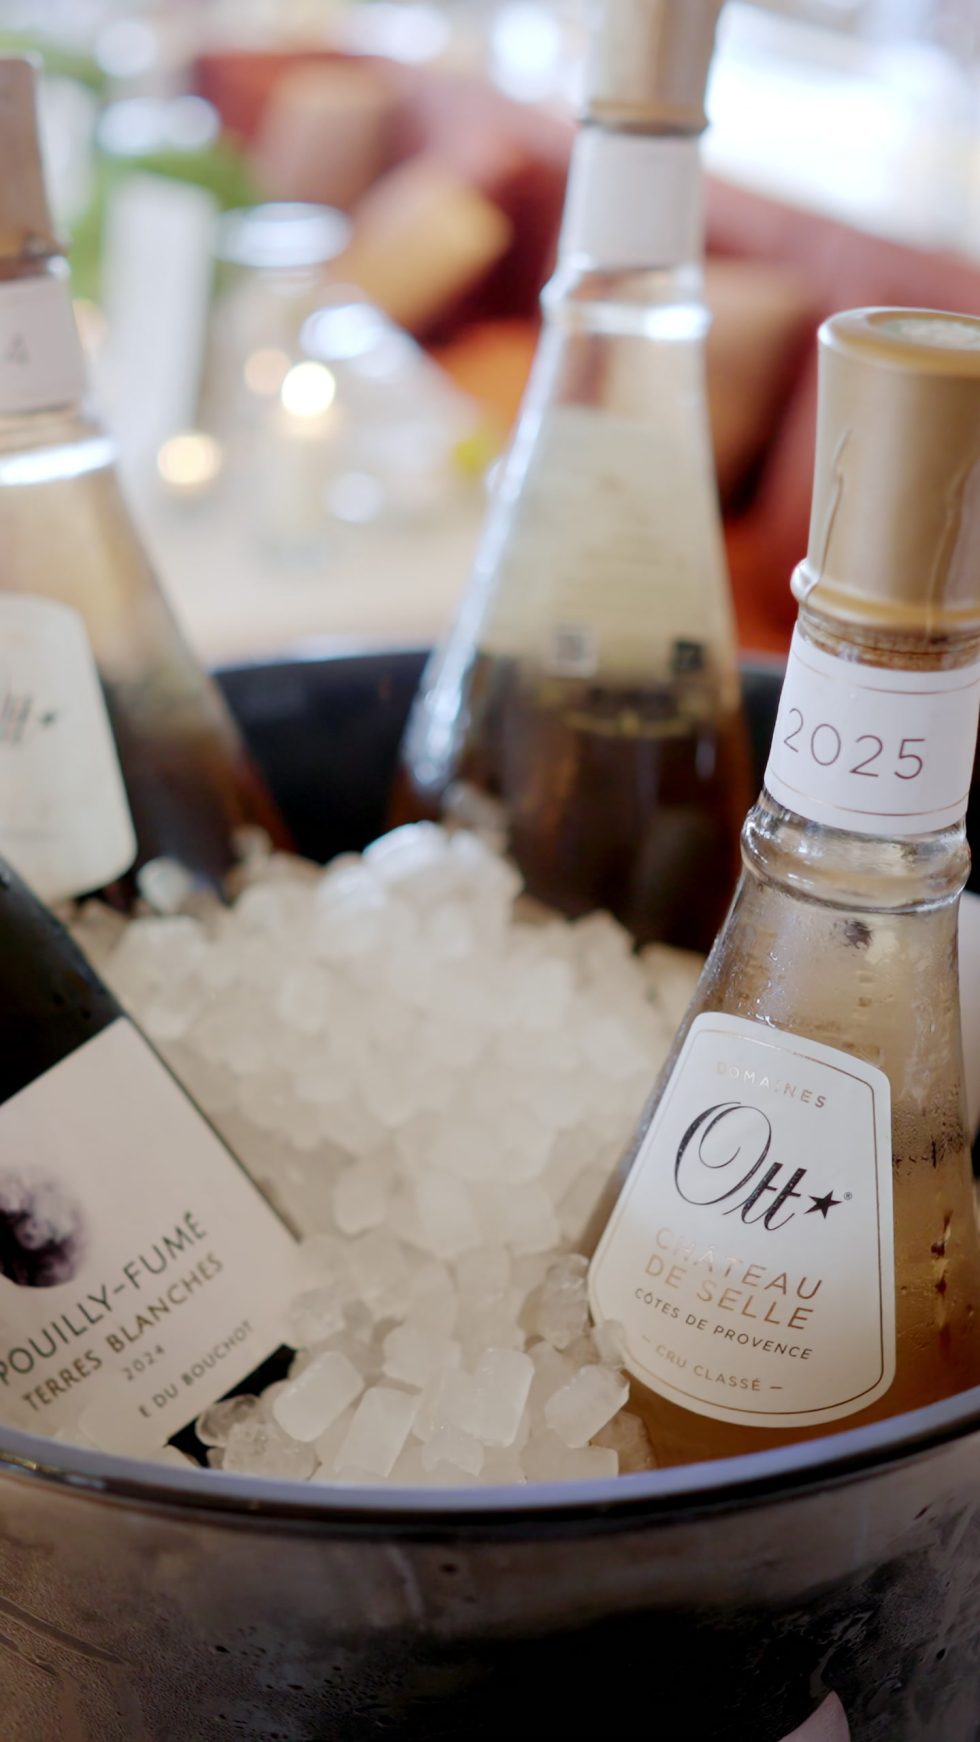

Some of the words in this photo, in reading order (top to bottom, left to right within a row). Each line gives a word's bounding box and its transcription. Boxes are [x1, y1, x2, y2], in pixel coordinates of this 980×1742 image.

[783, 707, 925, 780] 2025
[674, 1101, 808, 1232] Ott
[645, 1253, 687, 1289] DE
[696, 1279, 814, 1329] SELLE
[656, 1227, 823, 1300] CHÂTEAU
[22, 1349, 103, 1411] TERRES
[105, 1252, 223, 1353] BLANCHES
[121, 1344, 165, 1381] 2024
[151, 1383, 179, 1408] DU
[181, 1319, 254, 1387] BOUCHOT
[655, 1344, 688, 1369] CRU
[693, 1364, 761, 1391] CLASSÉ
[685, 1313, 709, 1331] DE
[713, 1325, 813, 1360] PROVENCE
